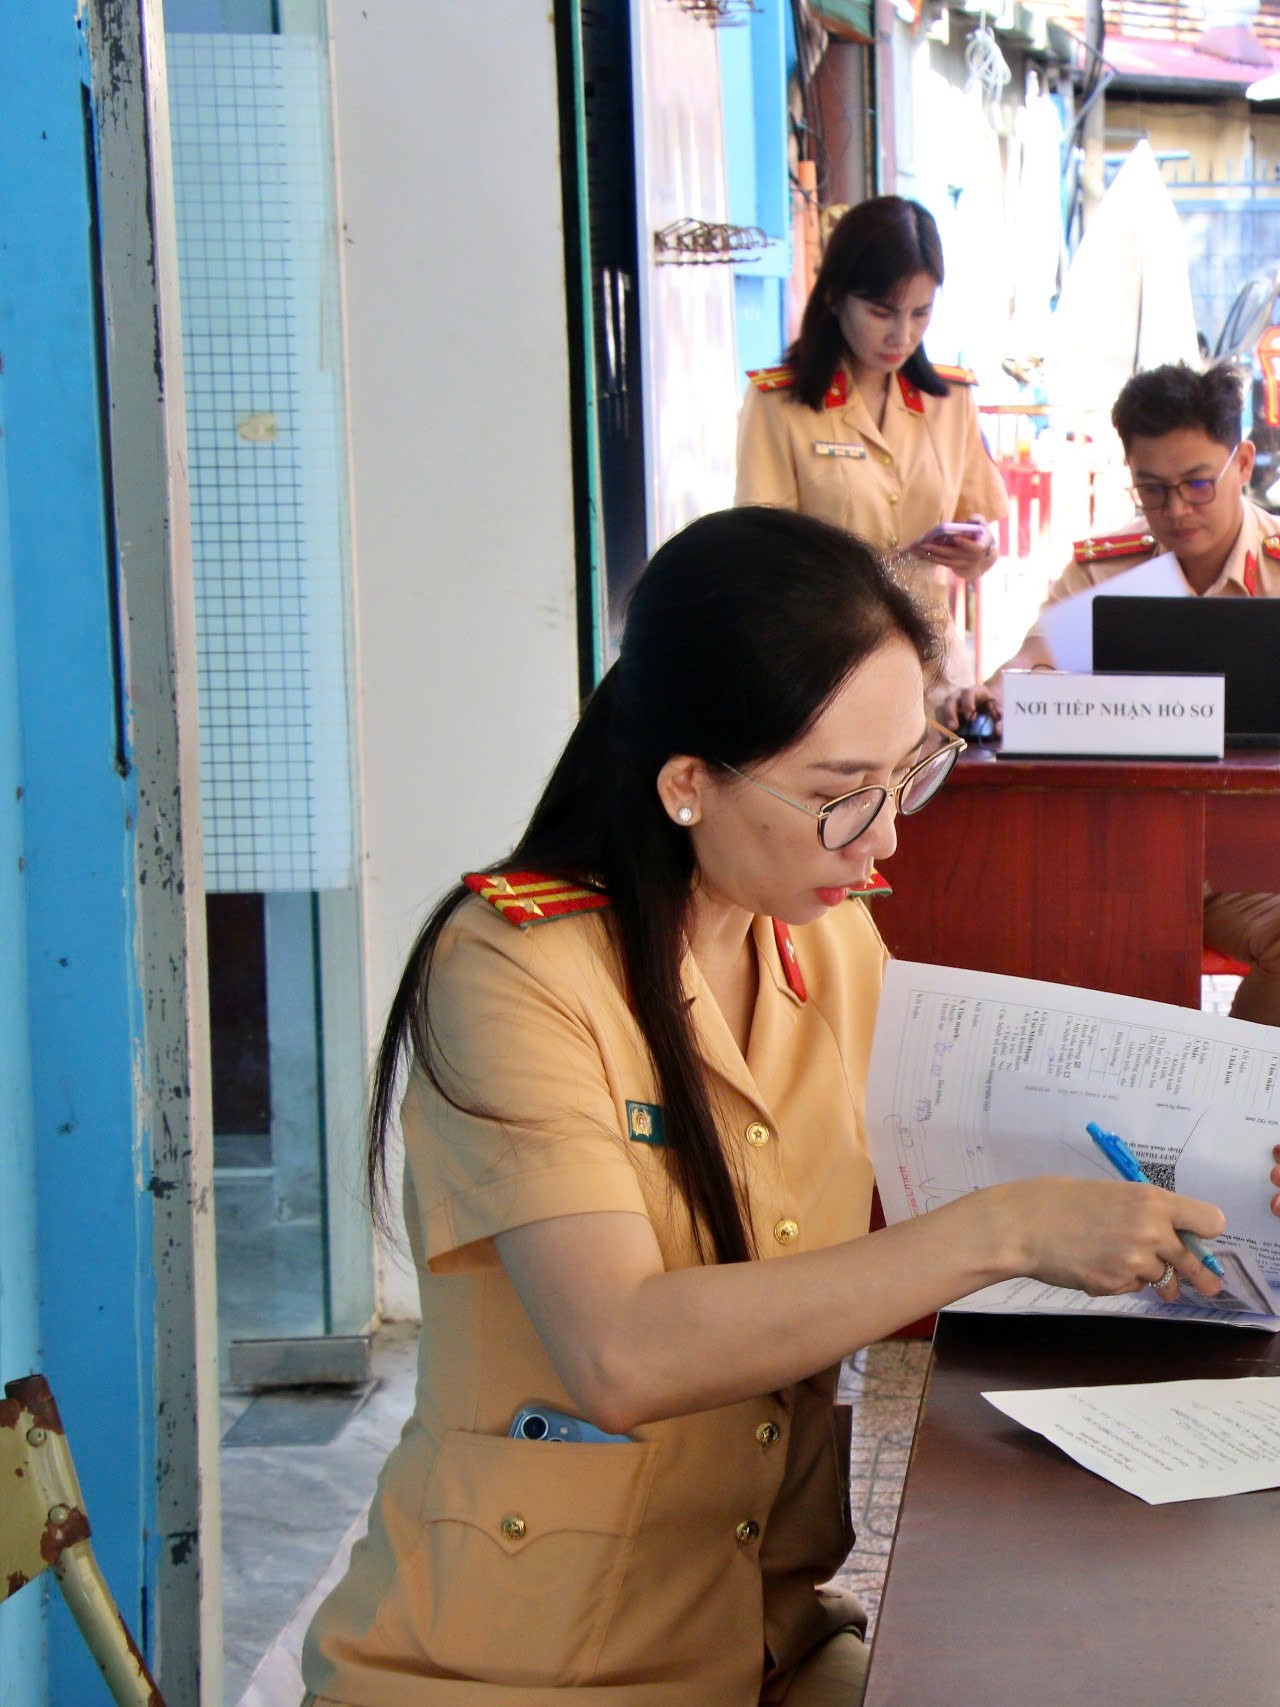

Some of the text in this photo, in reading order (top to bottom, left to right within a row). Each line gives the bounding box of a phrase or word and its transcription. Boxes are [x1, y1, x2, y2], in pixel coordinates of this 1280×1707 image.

[1015, 699, 1215, 720] NƠI TIẾP NHẬN HỒ SƠ
